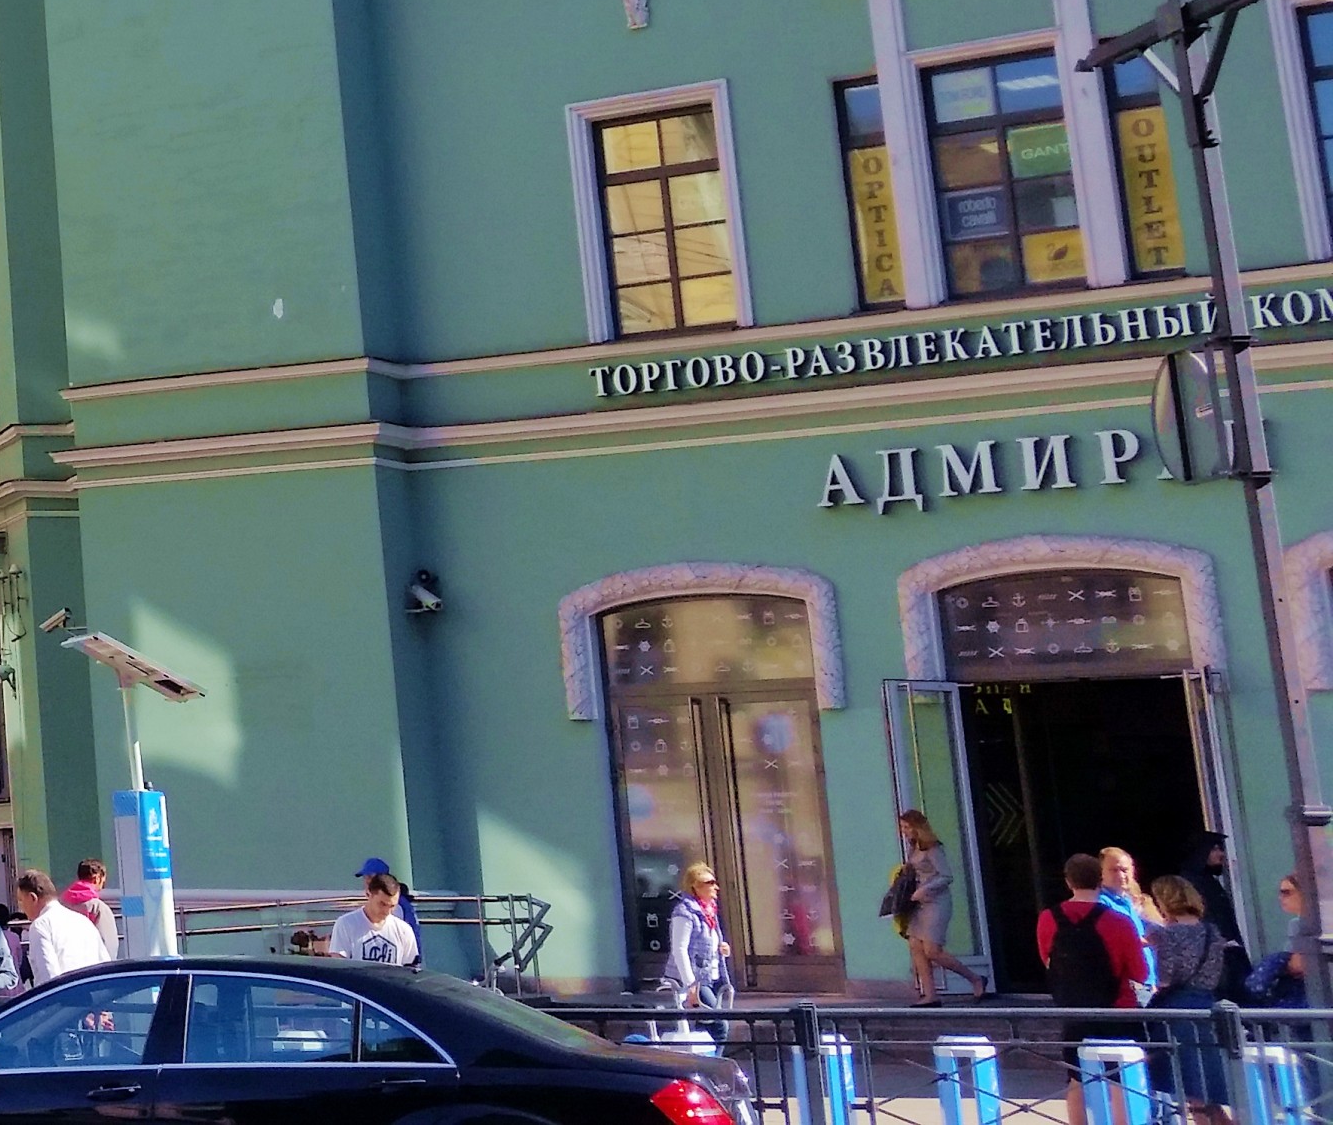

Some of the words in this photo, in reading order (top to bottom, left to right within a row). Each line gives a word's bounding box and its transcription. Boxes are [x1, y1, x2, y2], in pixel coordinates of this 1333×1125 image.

[1021, 142, 1069, 160] GANT
[1132, 118, 1169, 266] OUTLET
[862, 156, 899, 296] OPTICA
[817, 421, 1235, 515] АДМИР
